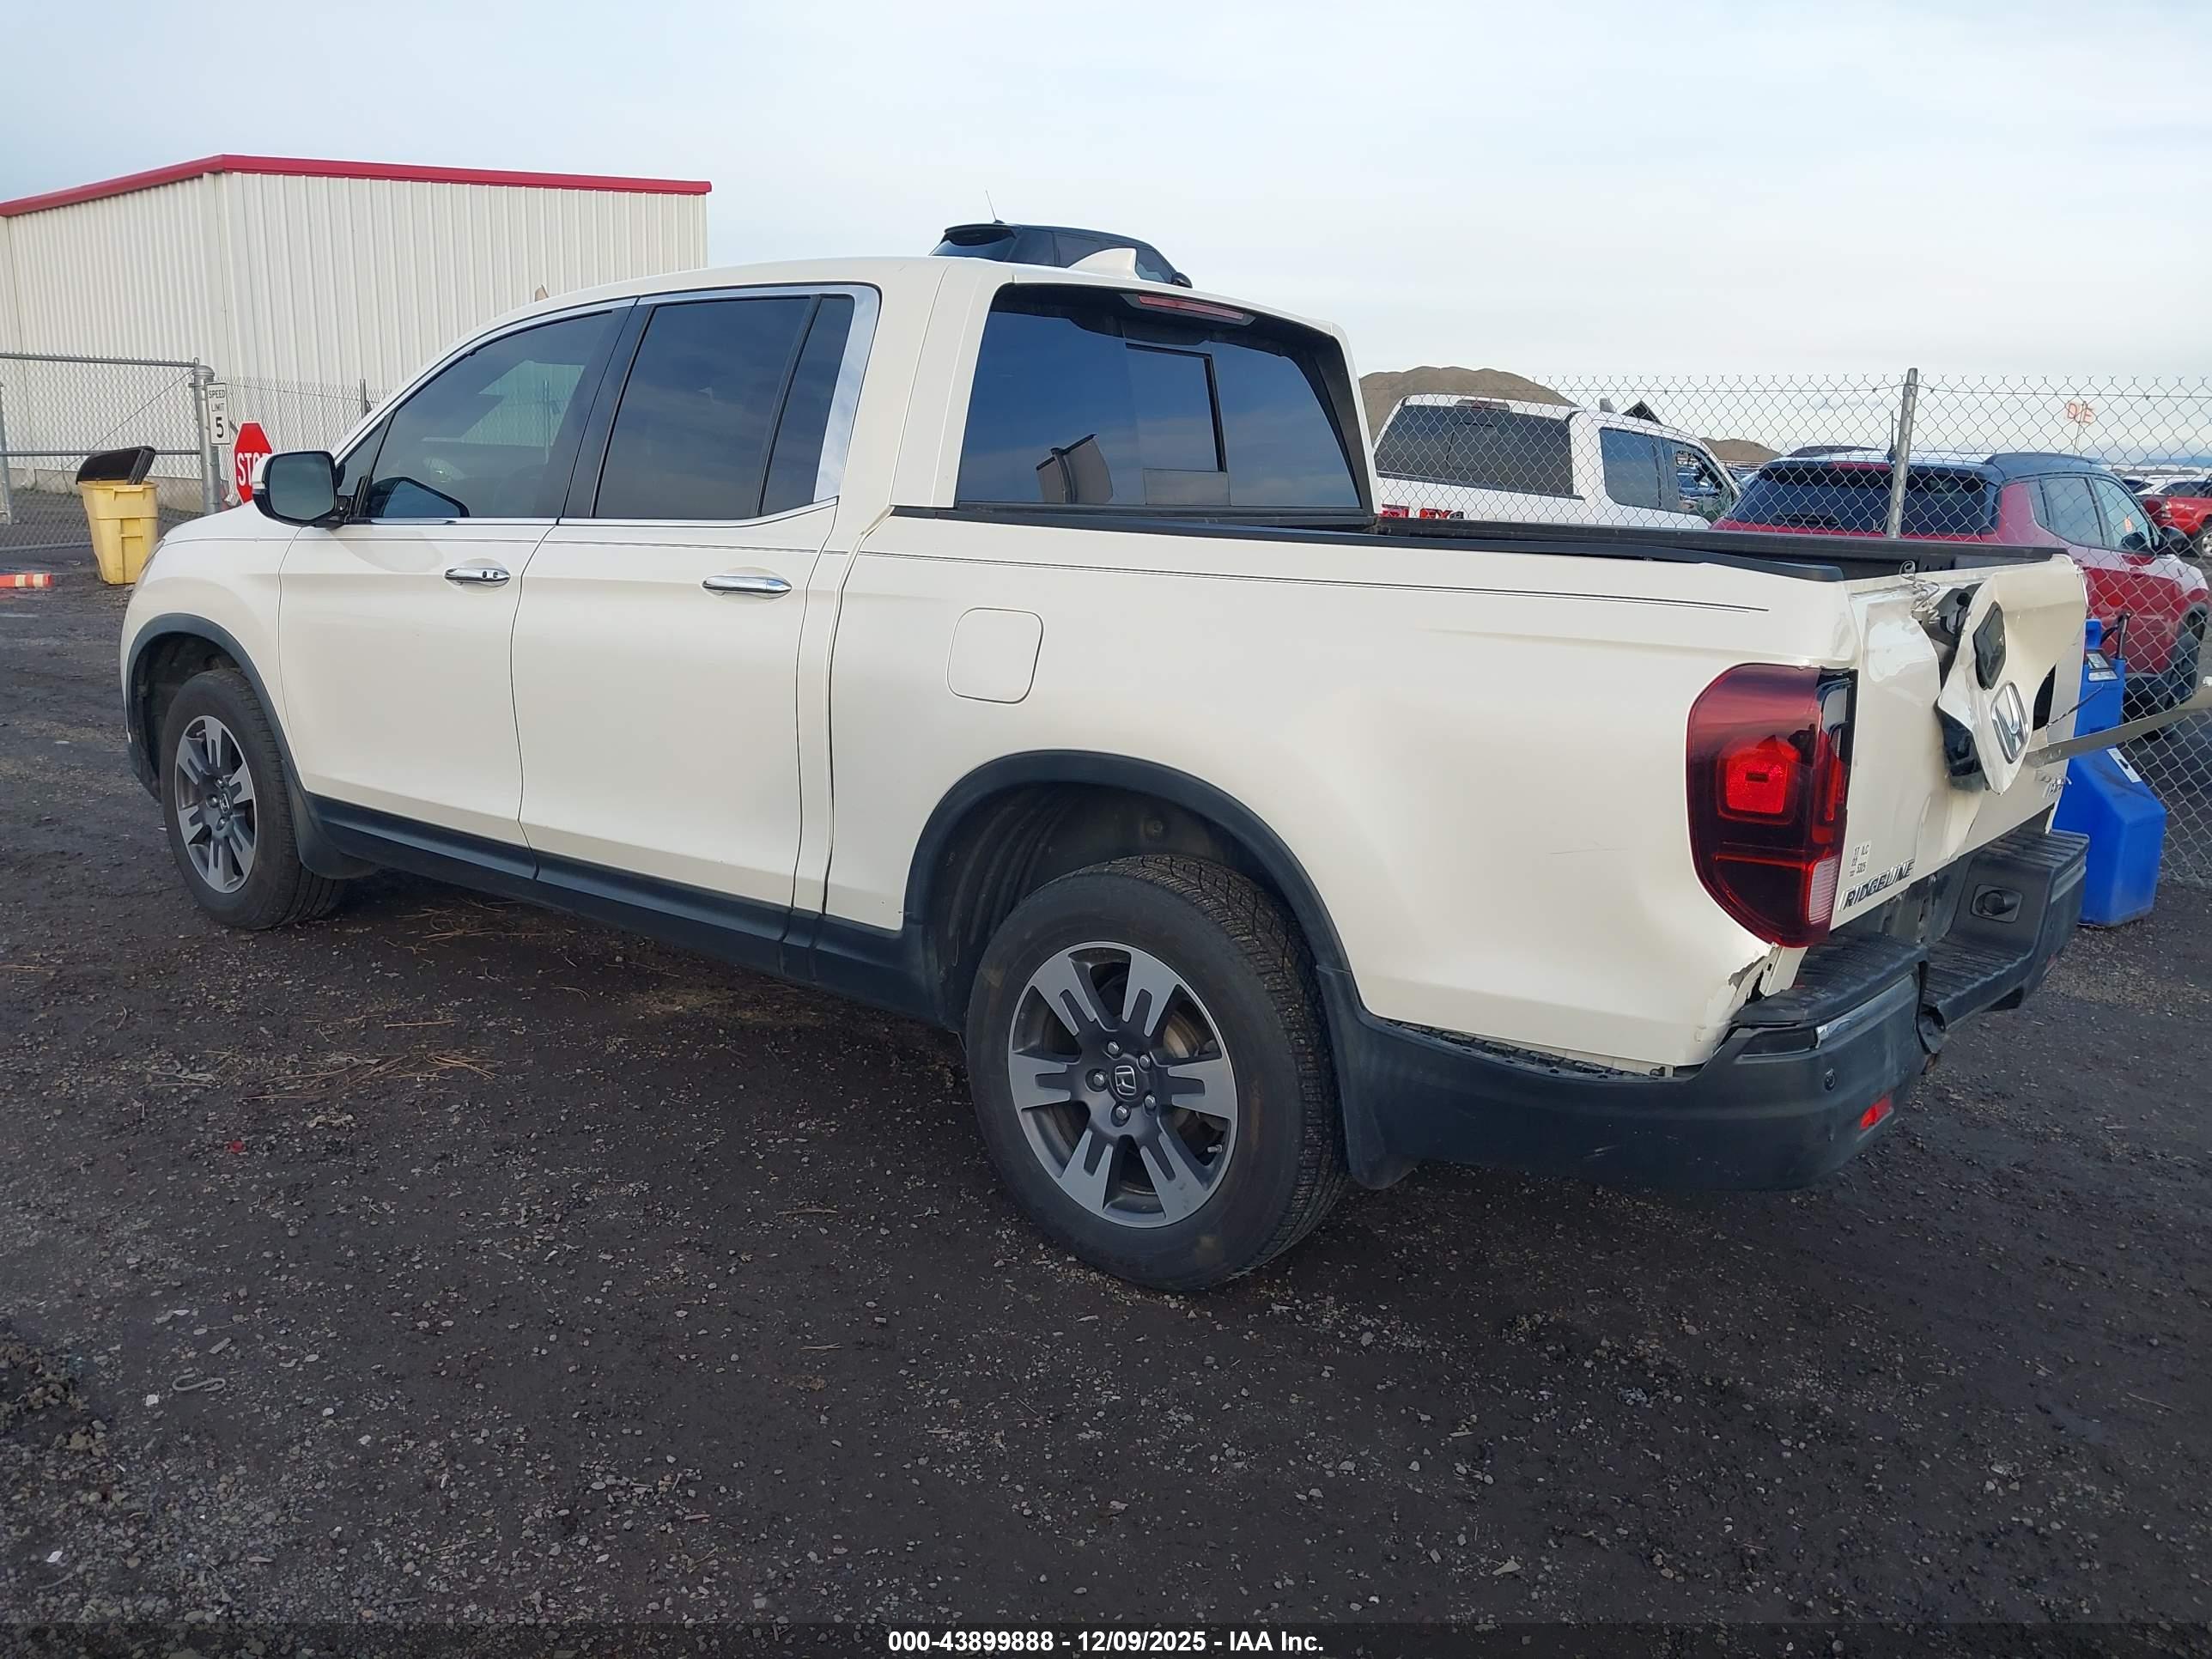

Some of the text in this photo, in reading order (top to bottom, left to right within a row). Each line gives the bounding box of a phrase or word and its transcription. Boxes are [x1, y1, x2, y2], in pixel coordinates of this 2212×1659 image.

[209, 390, 225, 398] SPEED
[211, 403, 224, 412] LIMIT
[216, 416, 224, 438] 5
[237, 452, 268, 487] ST
[1839, 859, 1915, 911] RIDGELINE
